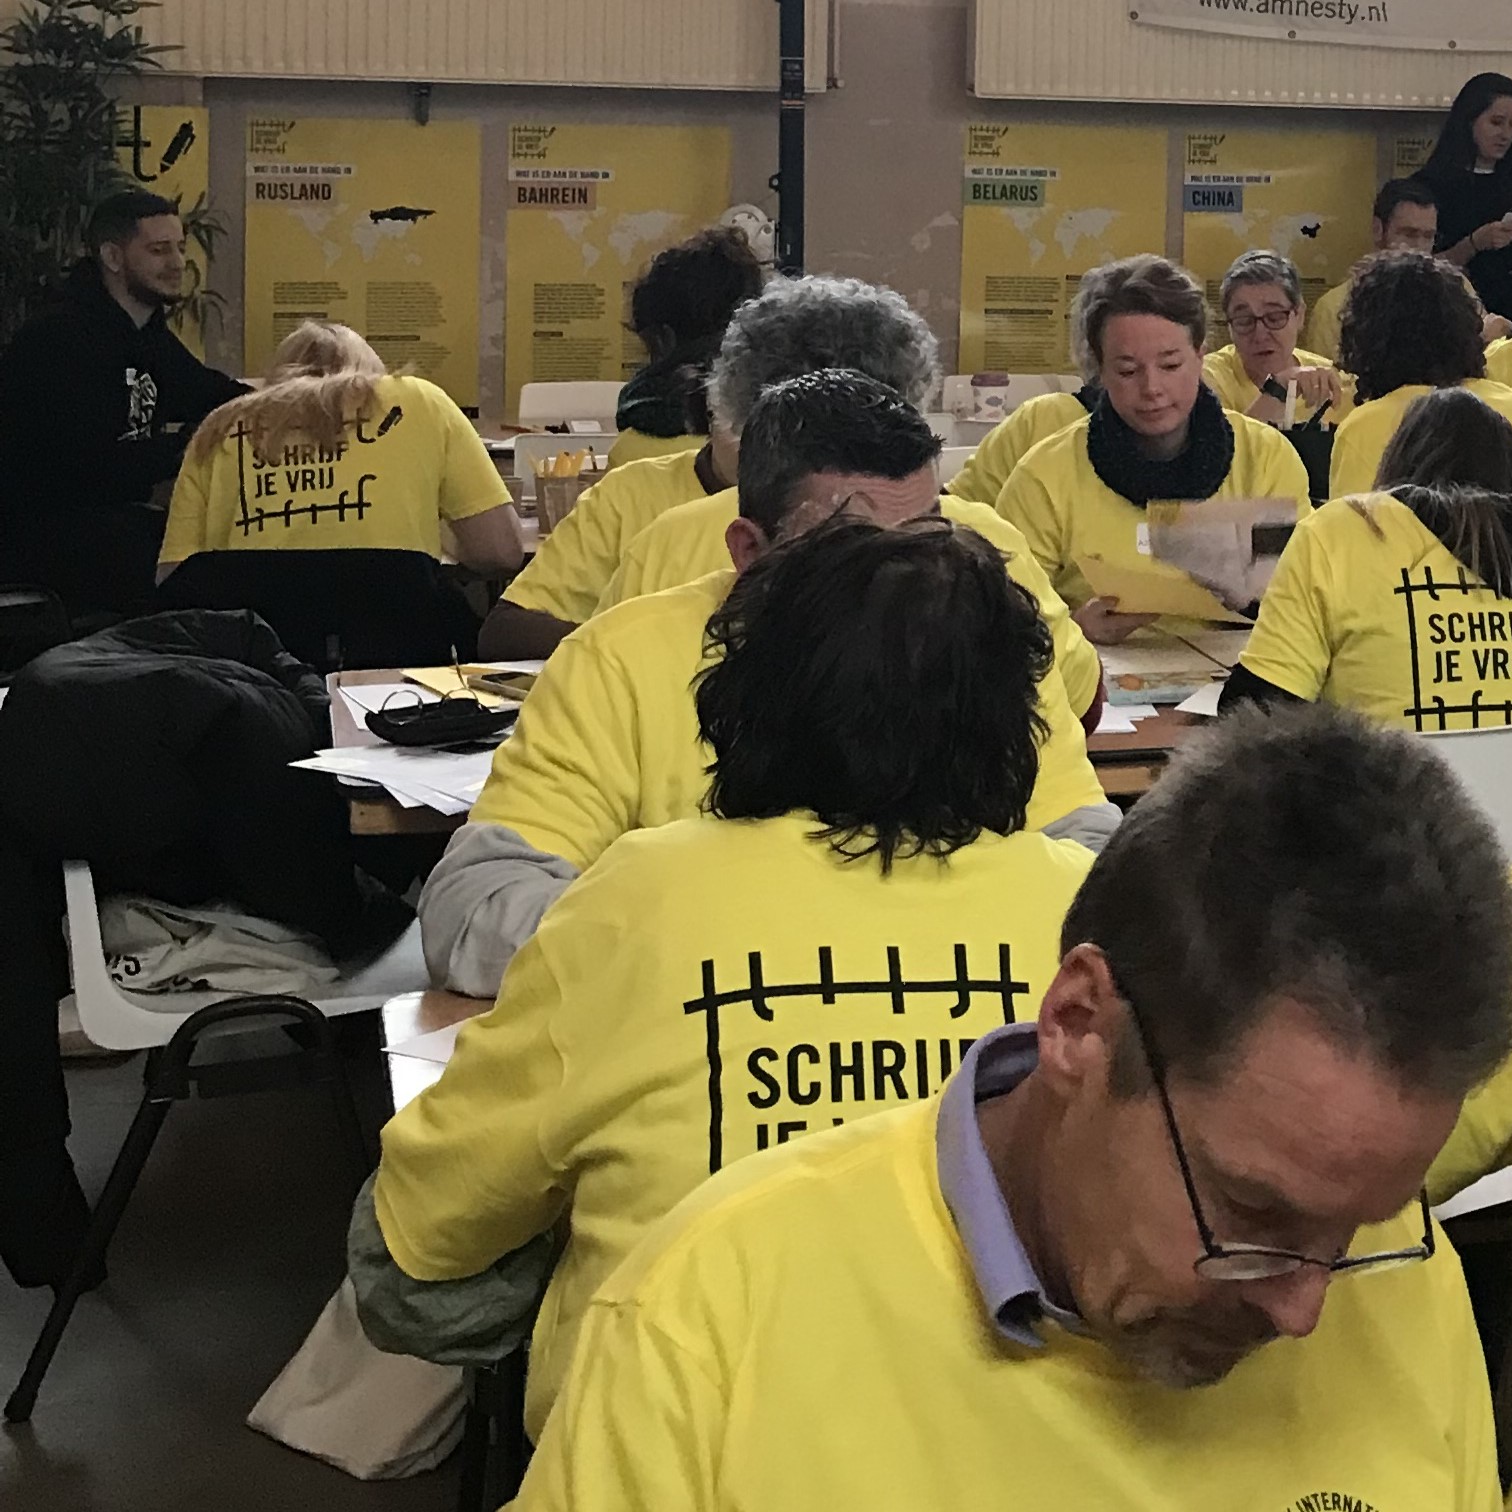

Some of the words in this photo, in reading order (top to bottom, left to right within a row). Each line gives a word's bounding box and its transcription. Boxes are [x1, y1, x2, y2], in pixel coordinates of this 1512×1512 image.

[255, 182, 332, 201] RUSLAND
[517, 186, 588, 204] BAHREIN
[972, 183, 1038, 201] BELARUS
[1192, 190, 1235, 206] CHINA
[254, 472, 278, 498] JE
[285, 466, 334, 493] VRIJ
[1432, 650, 1463, 684] JE
[1295, 1491, 1379, 1512] INTERNAT
